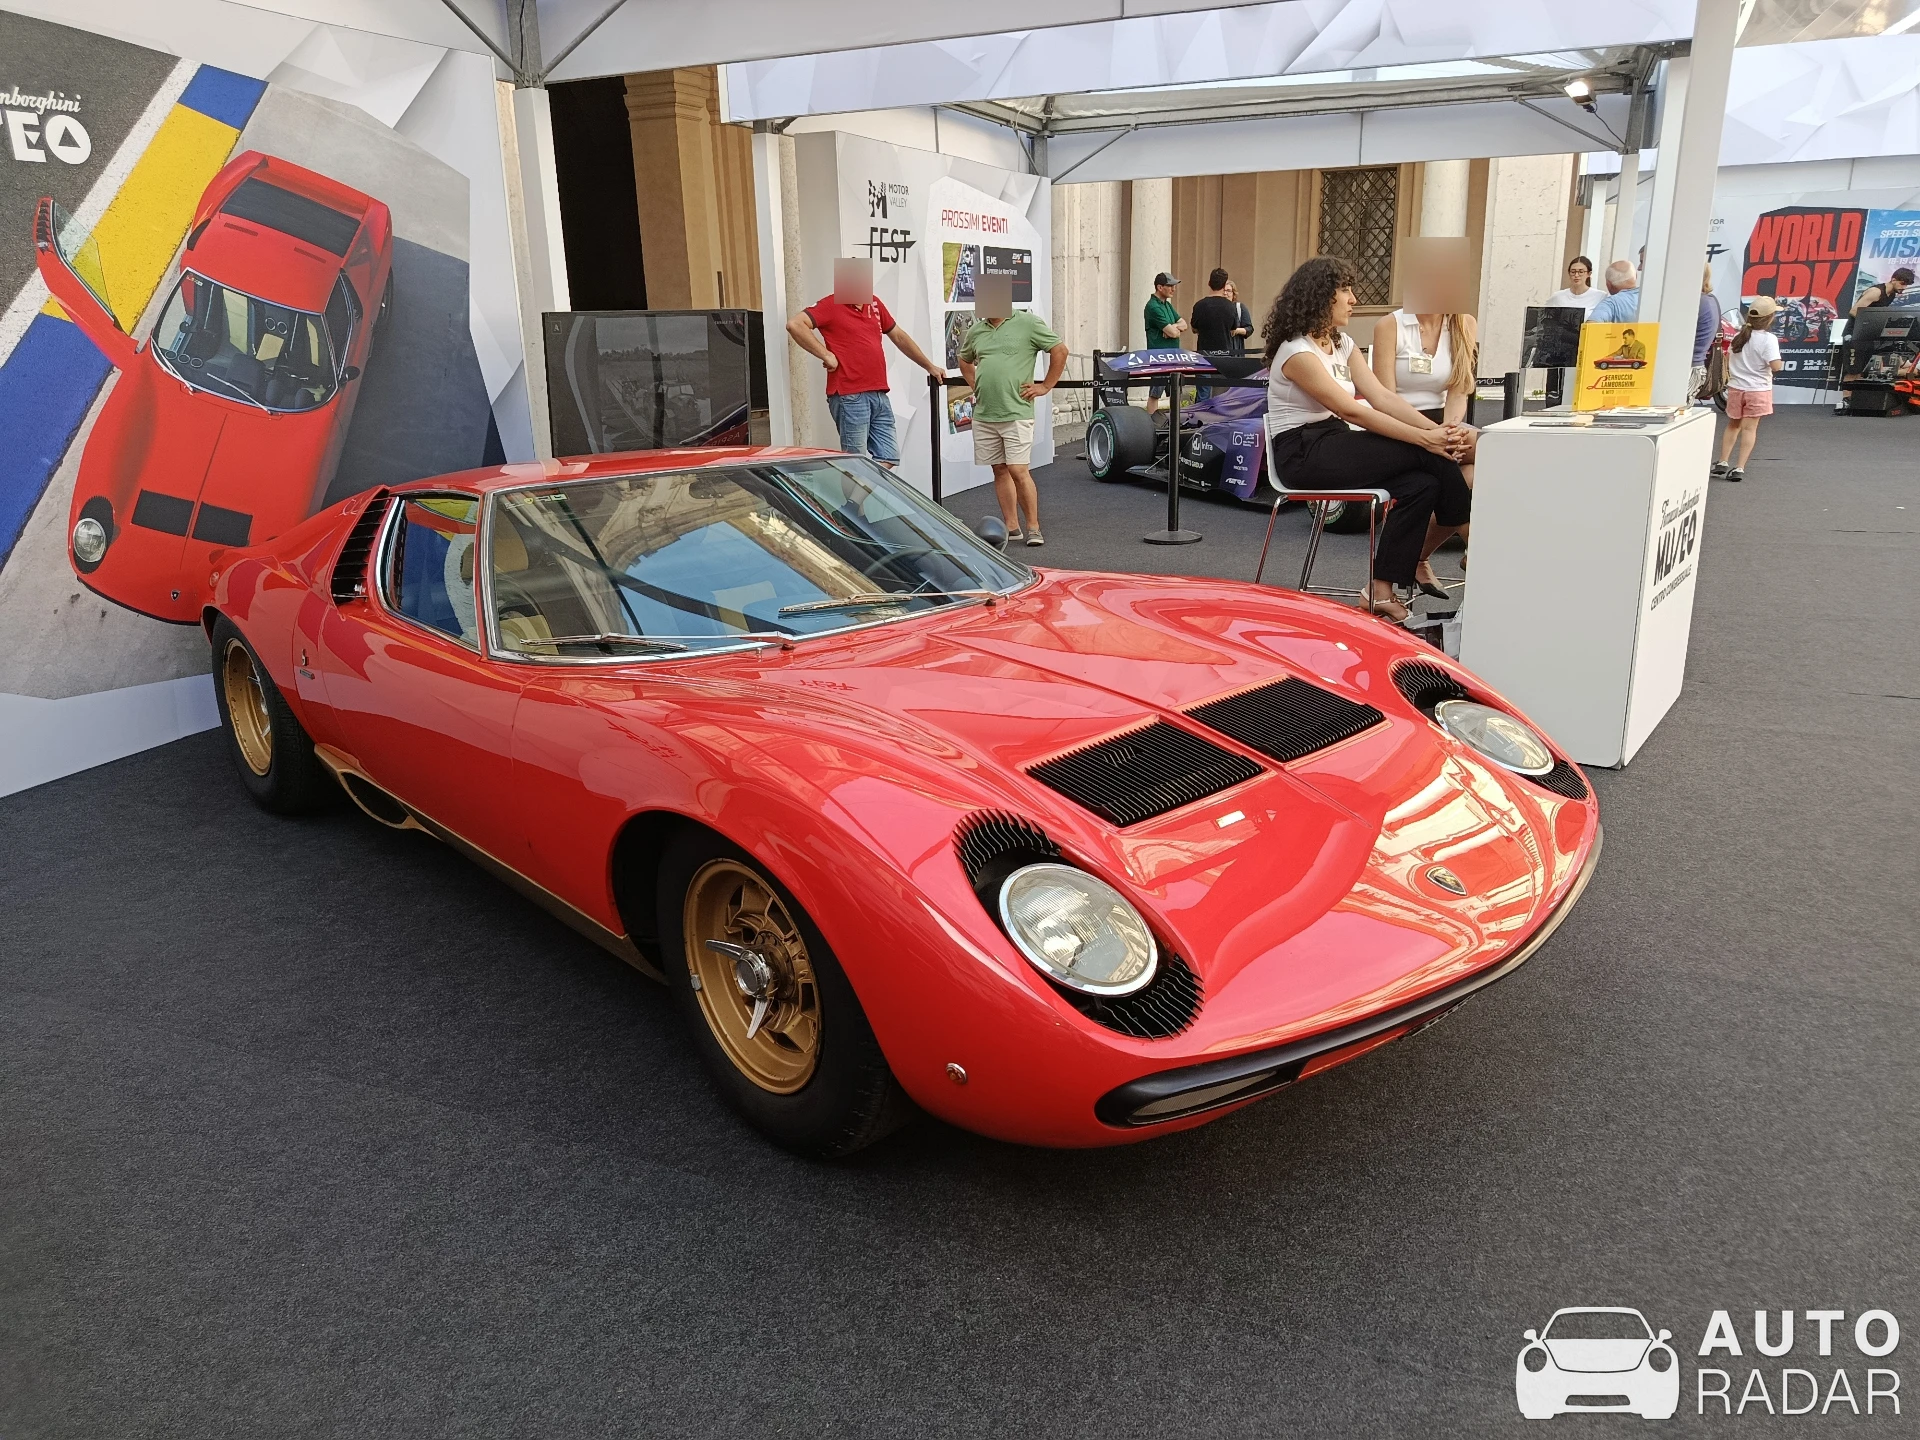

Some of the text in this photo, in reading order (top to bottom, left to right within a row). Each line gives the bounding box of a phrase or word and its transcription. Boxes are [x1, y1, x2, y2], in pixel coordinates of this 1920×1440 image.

[0, 109, 92, 165] EO
[888, 183, 909, 195] MOTOR
[889, 196, 908, 208] VALLEY
[941, 209, 1009, 234] PROSSIMI EVENTI
[869, 226, 911, 264] FEST
[1750, 212, 1863, 263] WORLD
[1149, 353, 1200, 363] ASPIRE
